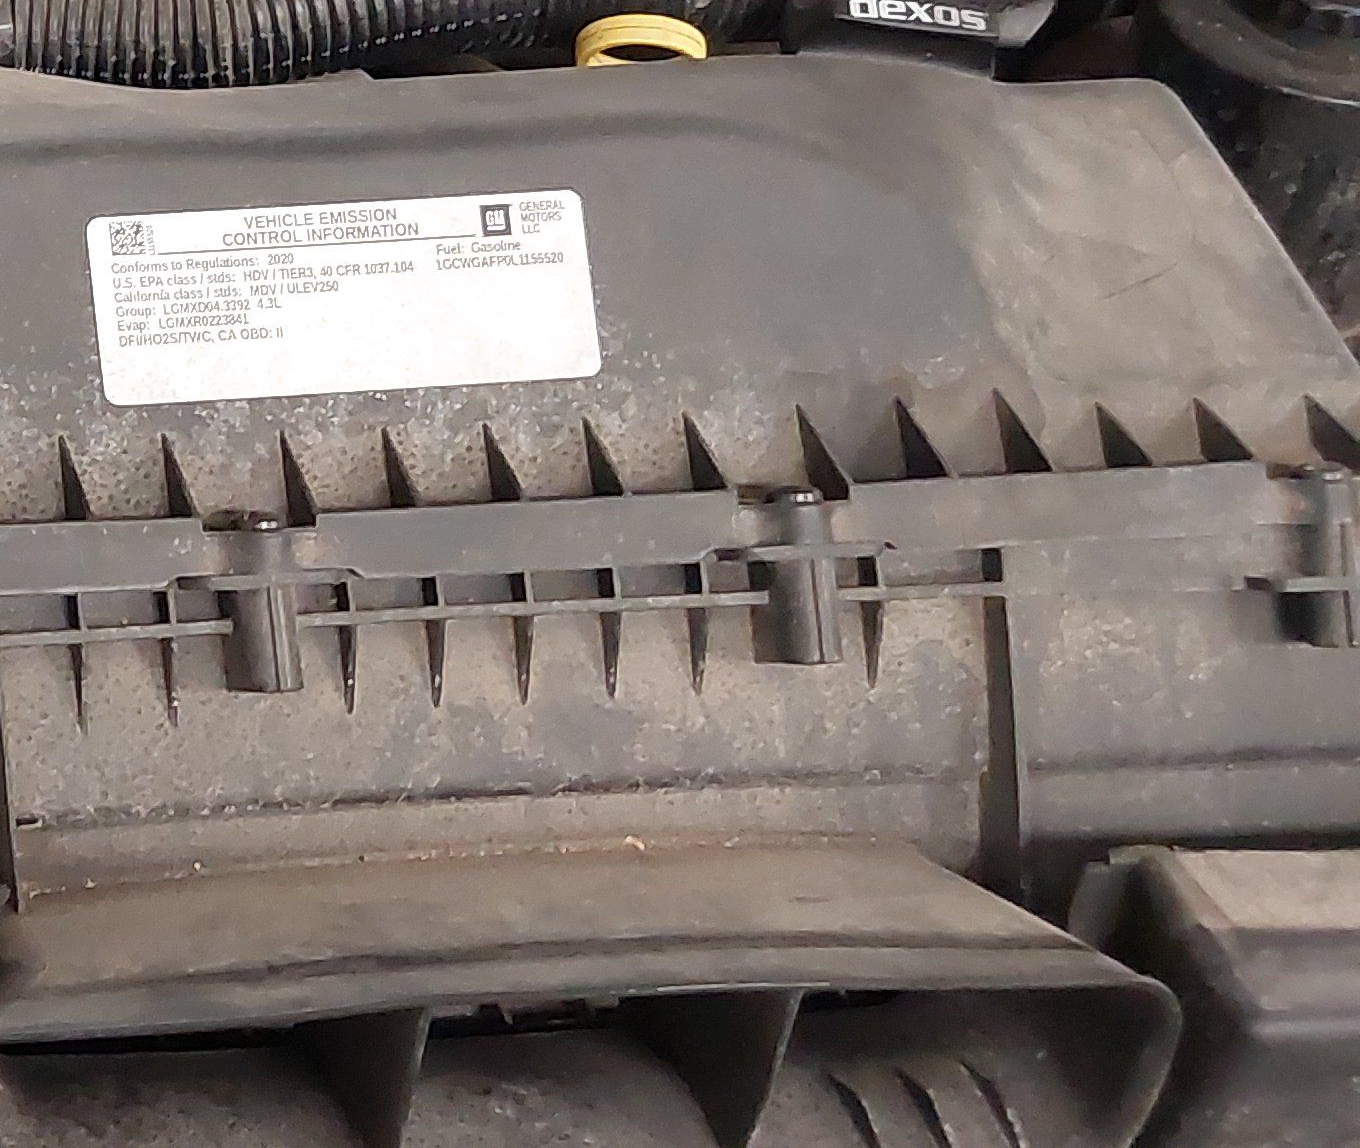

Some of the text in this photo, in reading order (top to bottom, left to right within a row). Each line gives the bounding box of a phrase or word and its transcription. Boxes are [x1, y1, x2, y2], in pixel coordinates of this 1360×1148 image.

[519, 200, 566, 212] GENERAL
[243, 208, 398, 229] VEHICLE EMISSION
[521, 212, 562, 223] MOTORS
[222, 222, 420, 247] CONTROL INFORMATION
[522, 223, 541, 234] LLC
[436, 240, 522, 255] Fuel: Gasoline
[111, 252, 294, 274] Conforms to Regulations: 2020
[140, 276, 164, 287] EPA
[167, 273, 197, 286] class
[243, 270, 269, 282] HDV
[320, 265, 333, 277] 40
[336, 263, 361, 276] CFR
[364, 260, 415, 275] 1037.104
[114, 288, 170, 303] California
[173, 287, 204, 300] class
[250, 284, 277, 297] MDV
[287, 280, 339, 294] ULEV250
[115, 305, 156, 319] Group:
[117, 319, 150, 333] Evap:
[218, 329, 237, 340] CA
[240, 327, 273, 339] OBD:
